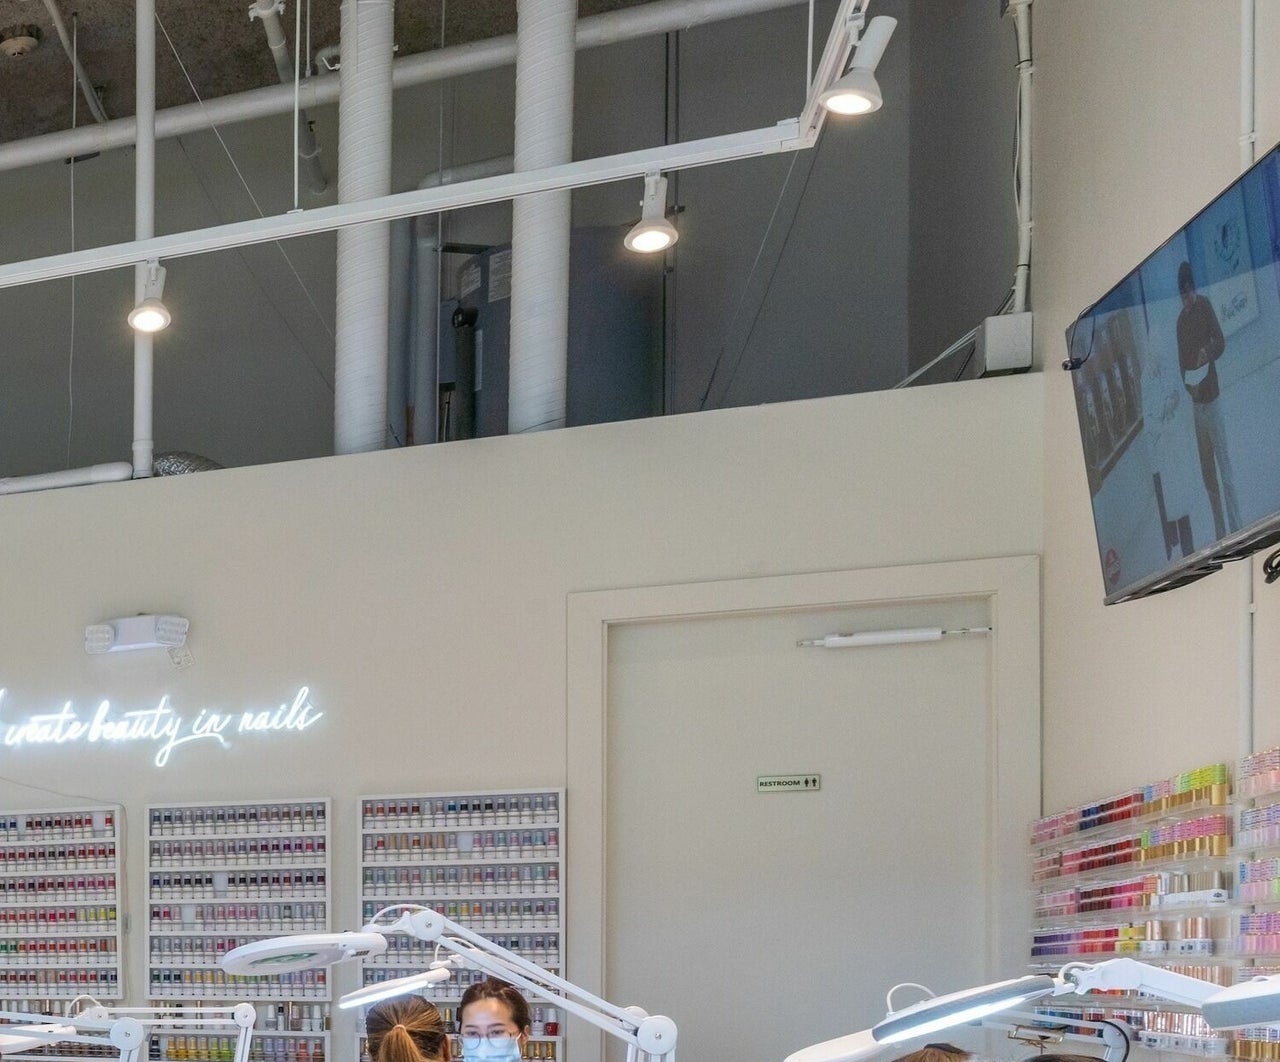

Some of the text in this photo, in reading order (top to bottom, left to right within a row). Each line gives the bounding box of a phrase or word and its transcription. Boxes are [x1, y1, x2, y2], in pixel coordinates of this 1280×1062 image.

[4, 699, 88, 747] create
[87, 694, 226, 767] beauty
[192, 707, 232, 735] in
[238, 686, 324, 732] nails
